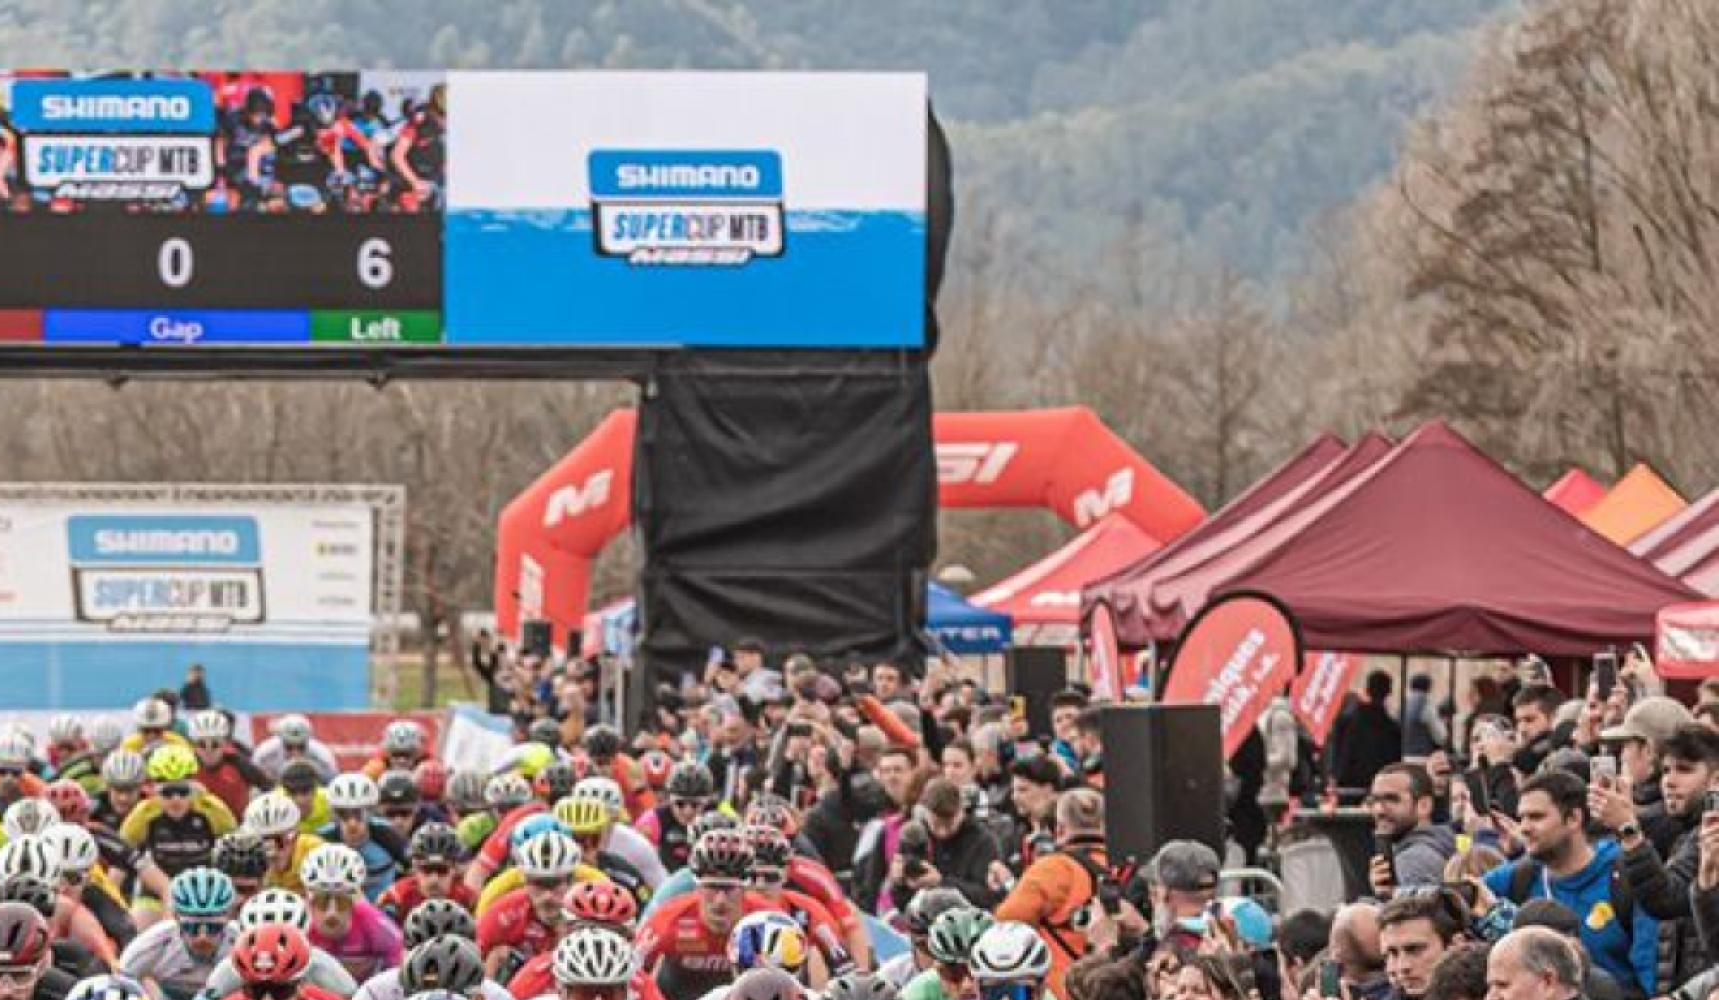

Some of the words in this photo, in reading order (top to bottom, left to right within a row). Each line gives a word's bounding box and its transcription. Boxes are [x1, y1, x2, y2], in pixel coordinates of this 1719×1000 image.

[42, 94, 191, 121] SHIMANO
[37, 144, 154, 173] SUPERCUP
[158, 145, 199, 174] MTB
[616, 165, 761, 190] SHIMANO
[613, 213, 726, 241] SUPERCUP
[730, 213, 769, 242] MTB
[158, 237, 194, 288] 0
[357, 237, 394, 289] 6
[149, 315, 205, 345] Gap
[350, 317, 403, 340] Left
[93, 529, 240, 555] SHIMANO
